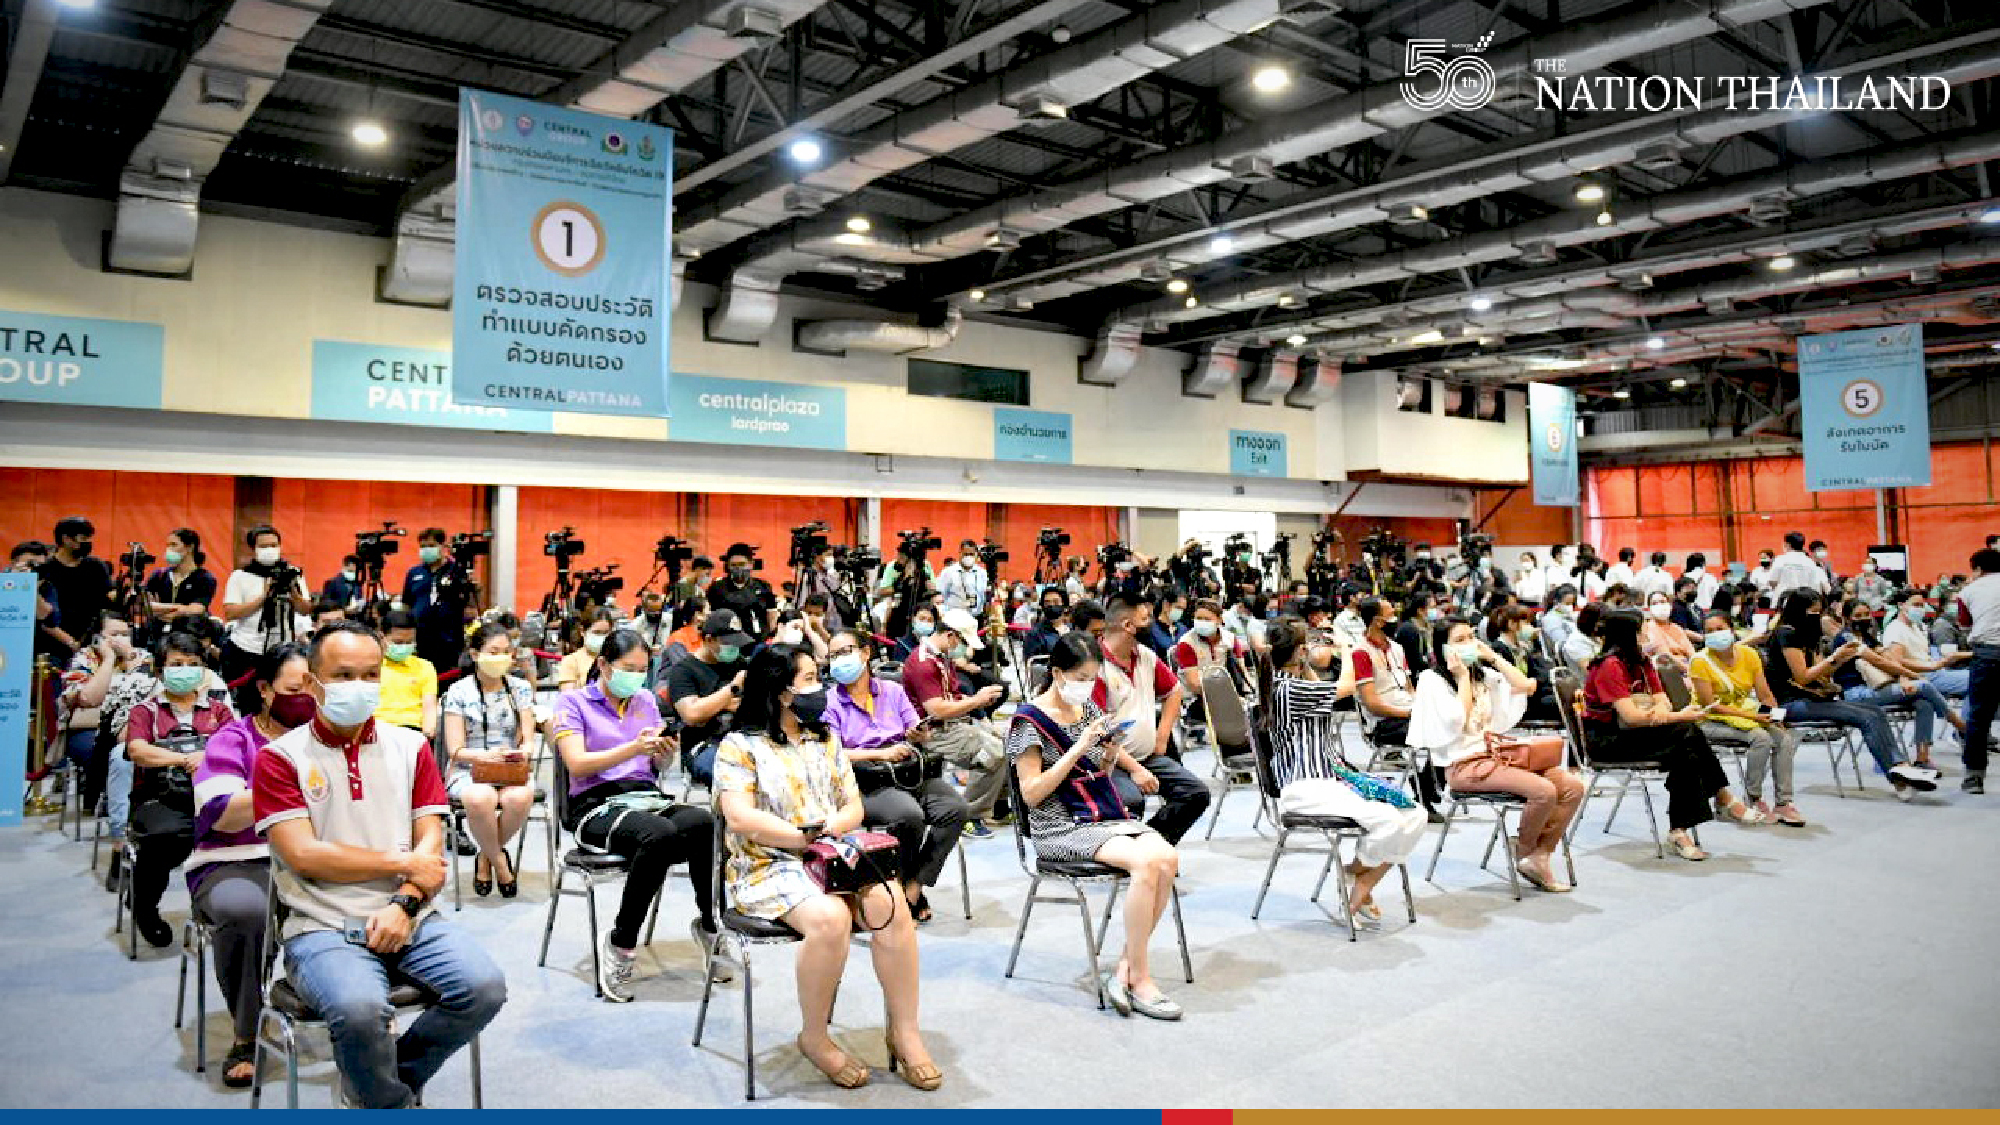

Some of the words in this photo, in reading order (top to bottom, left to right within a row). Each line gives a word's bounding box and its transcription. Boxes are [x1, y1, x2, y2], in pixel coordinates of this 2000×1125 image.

[562, 220, 573, 257] 1
[477, 284, 653, 317] ตรวจสอบประวัติ
[482, 308, 647, 345] ทำแบบคัดกรอง
[0, 327, 100, 358] TRAL
[506, 341, 624, 371] ด้วยตนเอง
[0, 358, 81, 386] OUP
[368, 386, 507, 418] PATTA
[699, 393, 820, 417] centralplaza
[1855, 389, 1870, 408] 5
[731, 416, 790, 433] lardprao
